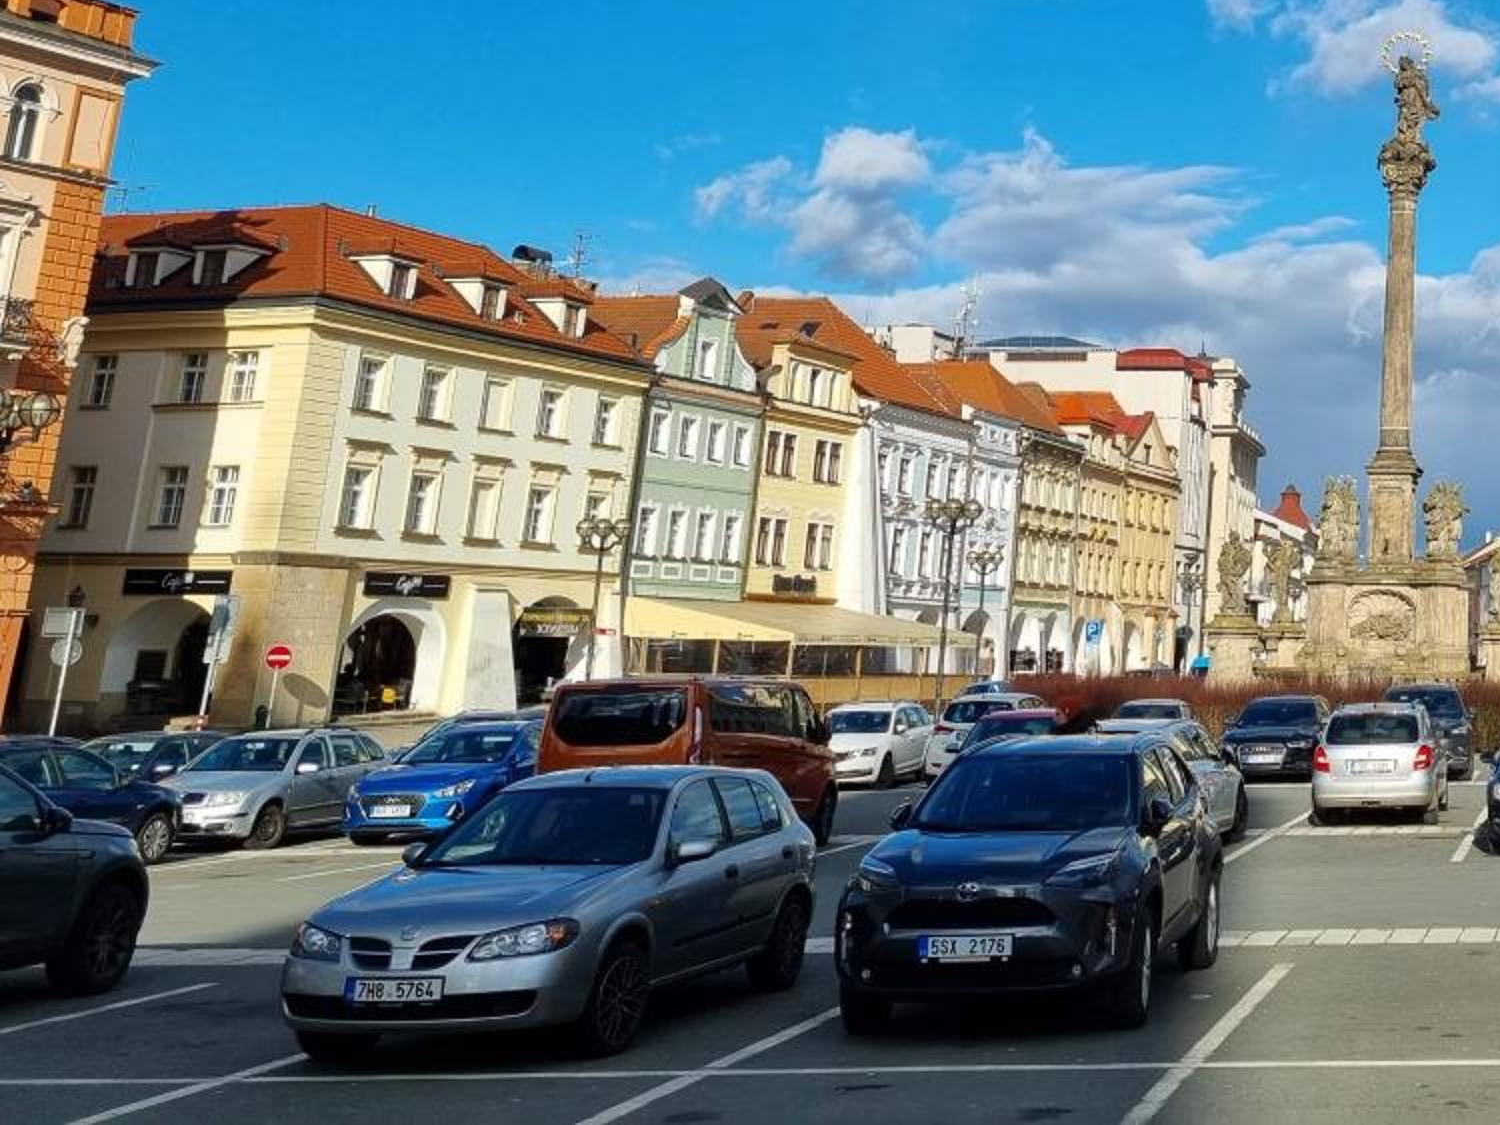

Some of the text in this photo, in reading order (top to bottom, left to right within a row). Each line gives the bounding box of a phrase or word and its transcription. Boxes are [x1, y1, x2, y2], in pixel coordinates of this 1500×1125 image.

[1087, 624, 1097, 636] P
[931, 939, 1005, 955] 5SX 2176
[358, 982, 433, 999] 7H8 5764
